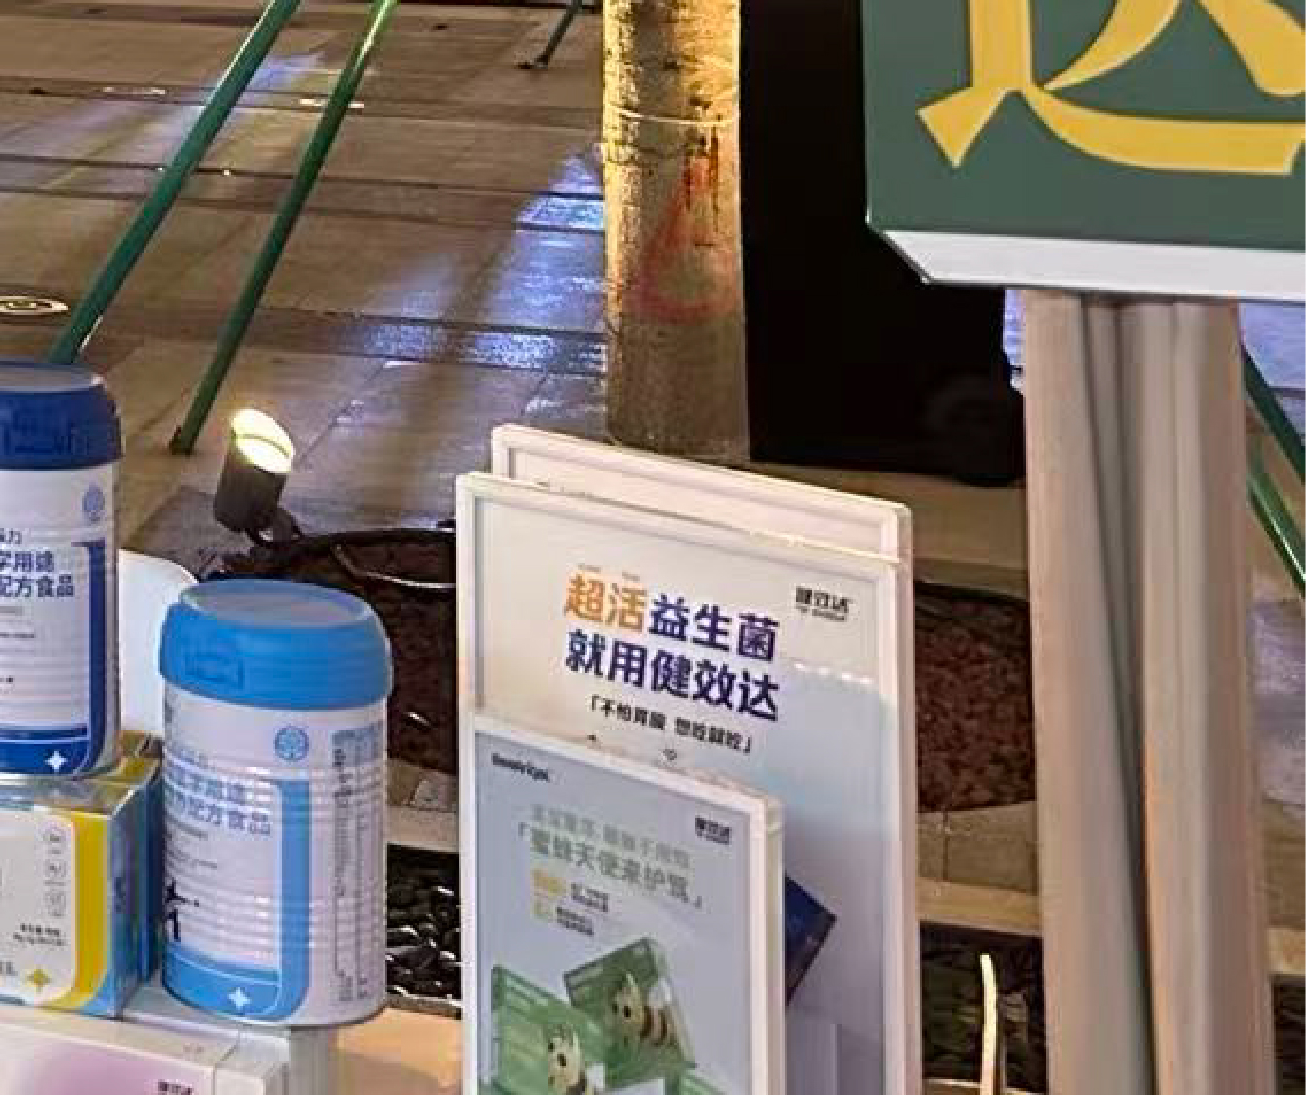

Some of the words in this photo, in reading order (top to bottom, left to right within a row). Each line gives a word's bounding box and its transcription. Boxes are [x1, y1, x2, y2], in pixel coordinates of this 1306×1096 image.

[564, 572, 780, 662] 超活益生菌
[564, 628, 780, 722] 就用健效达
